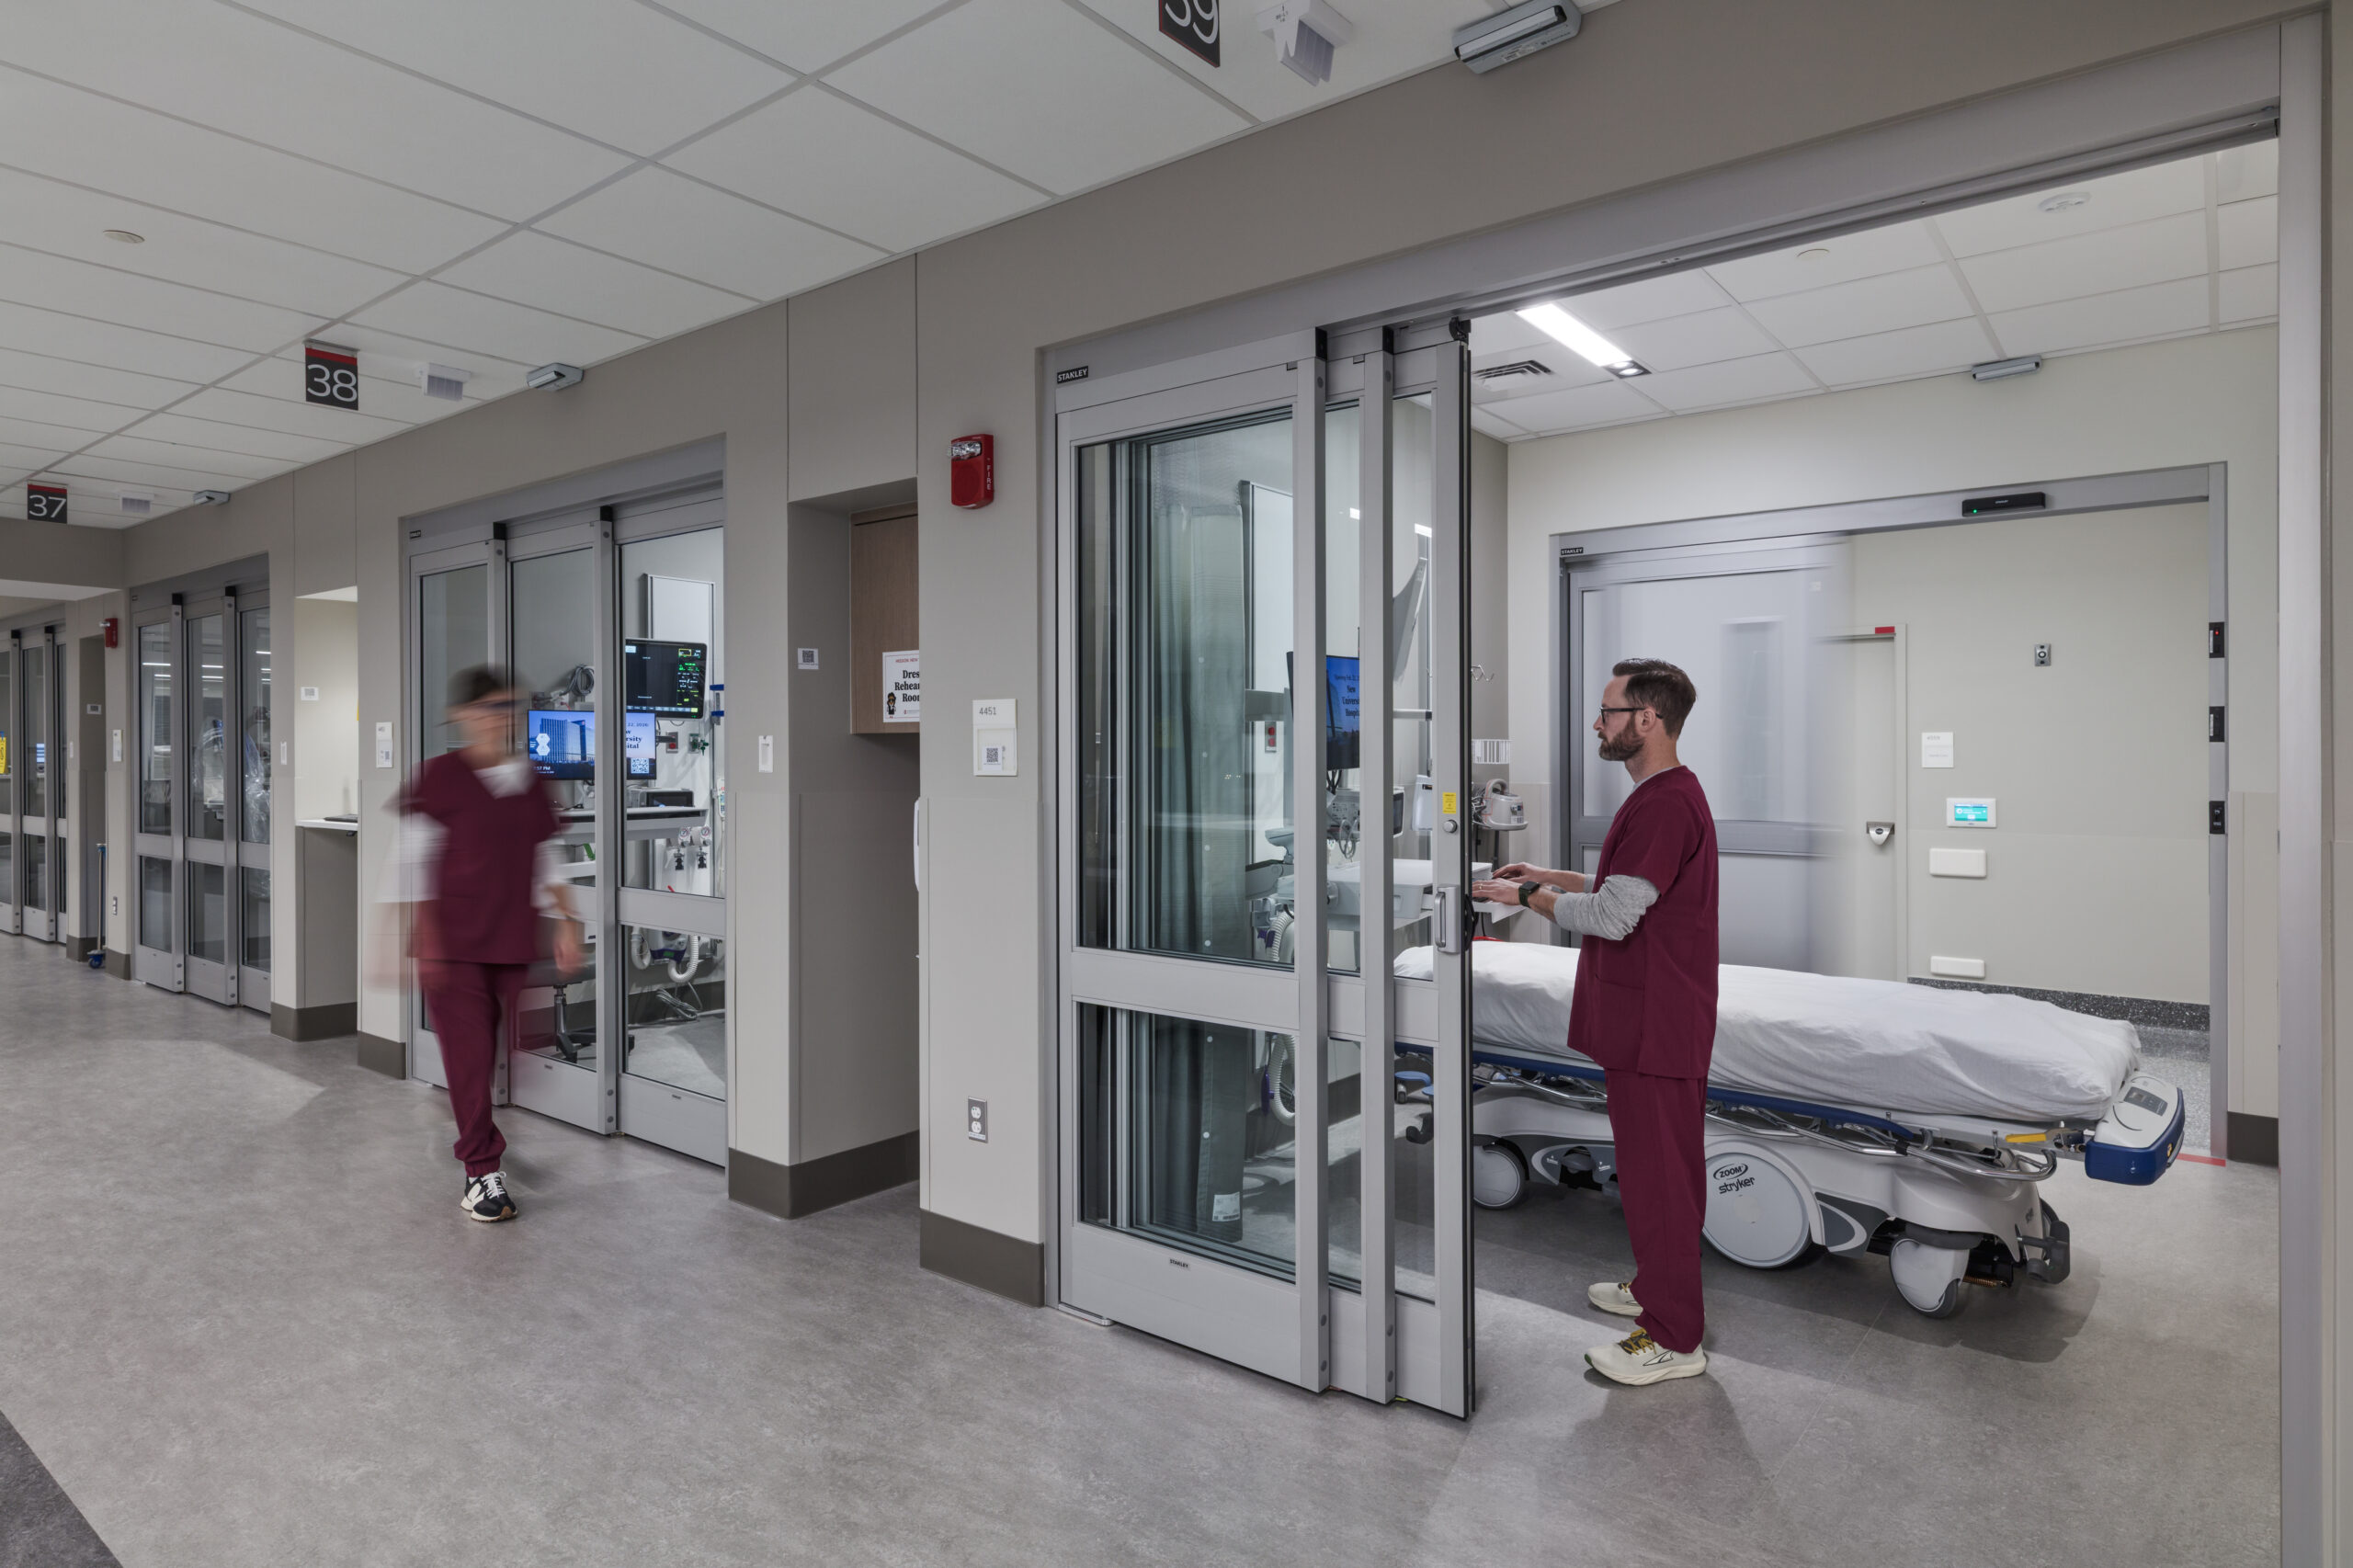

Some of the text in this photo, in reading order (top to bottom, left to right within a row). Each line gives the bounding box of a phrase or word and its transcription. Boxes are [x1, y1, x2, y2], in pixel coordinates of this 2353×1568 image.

[1058, 368, 1087, 381] STANLEY
[307, 364, 358, 402] 38
[29, 494, 66, 517] 37
[979, 707, 996, 715] 4451
[1720, 1165, 1743, 1178] ZOOM
[1719, 1177, 1755, 1195] stryker
